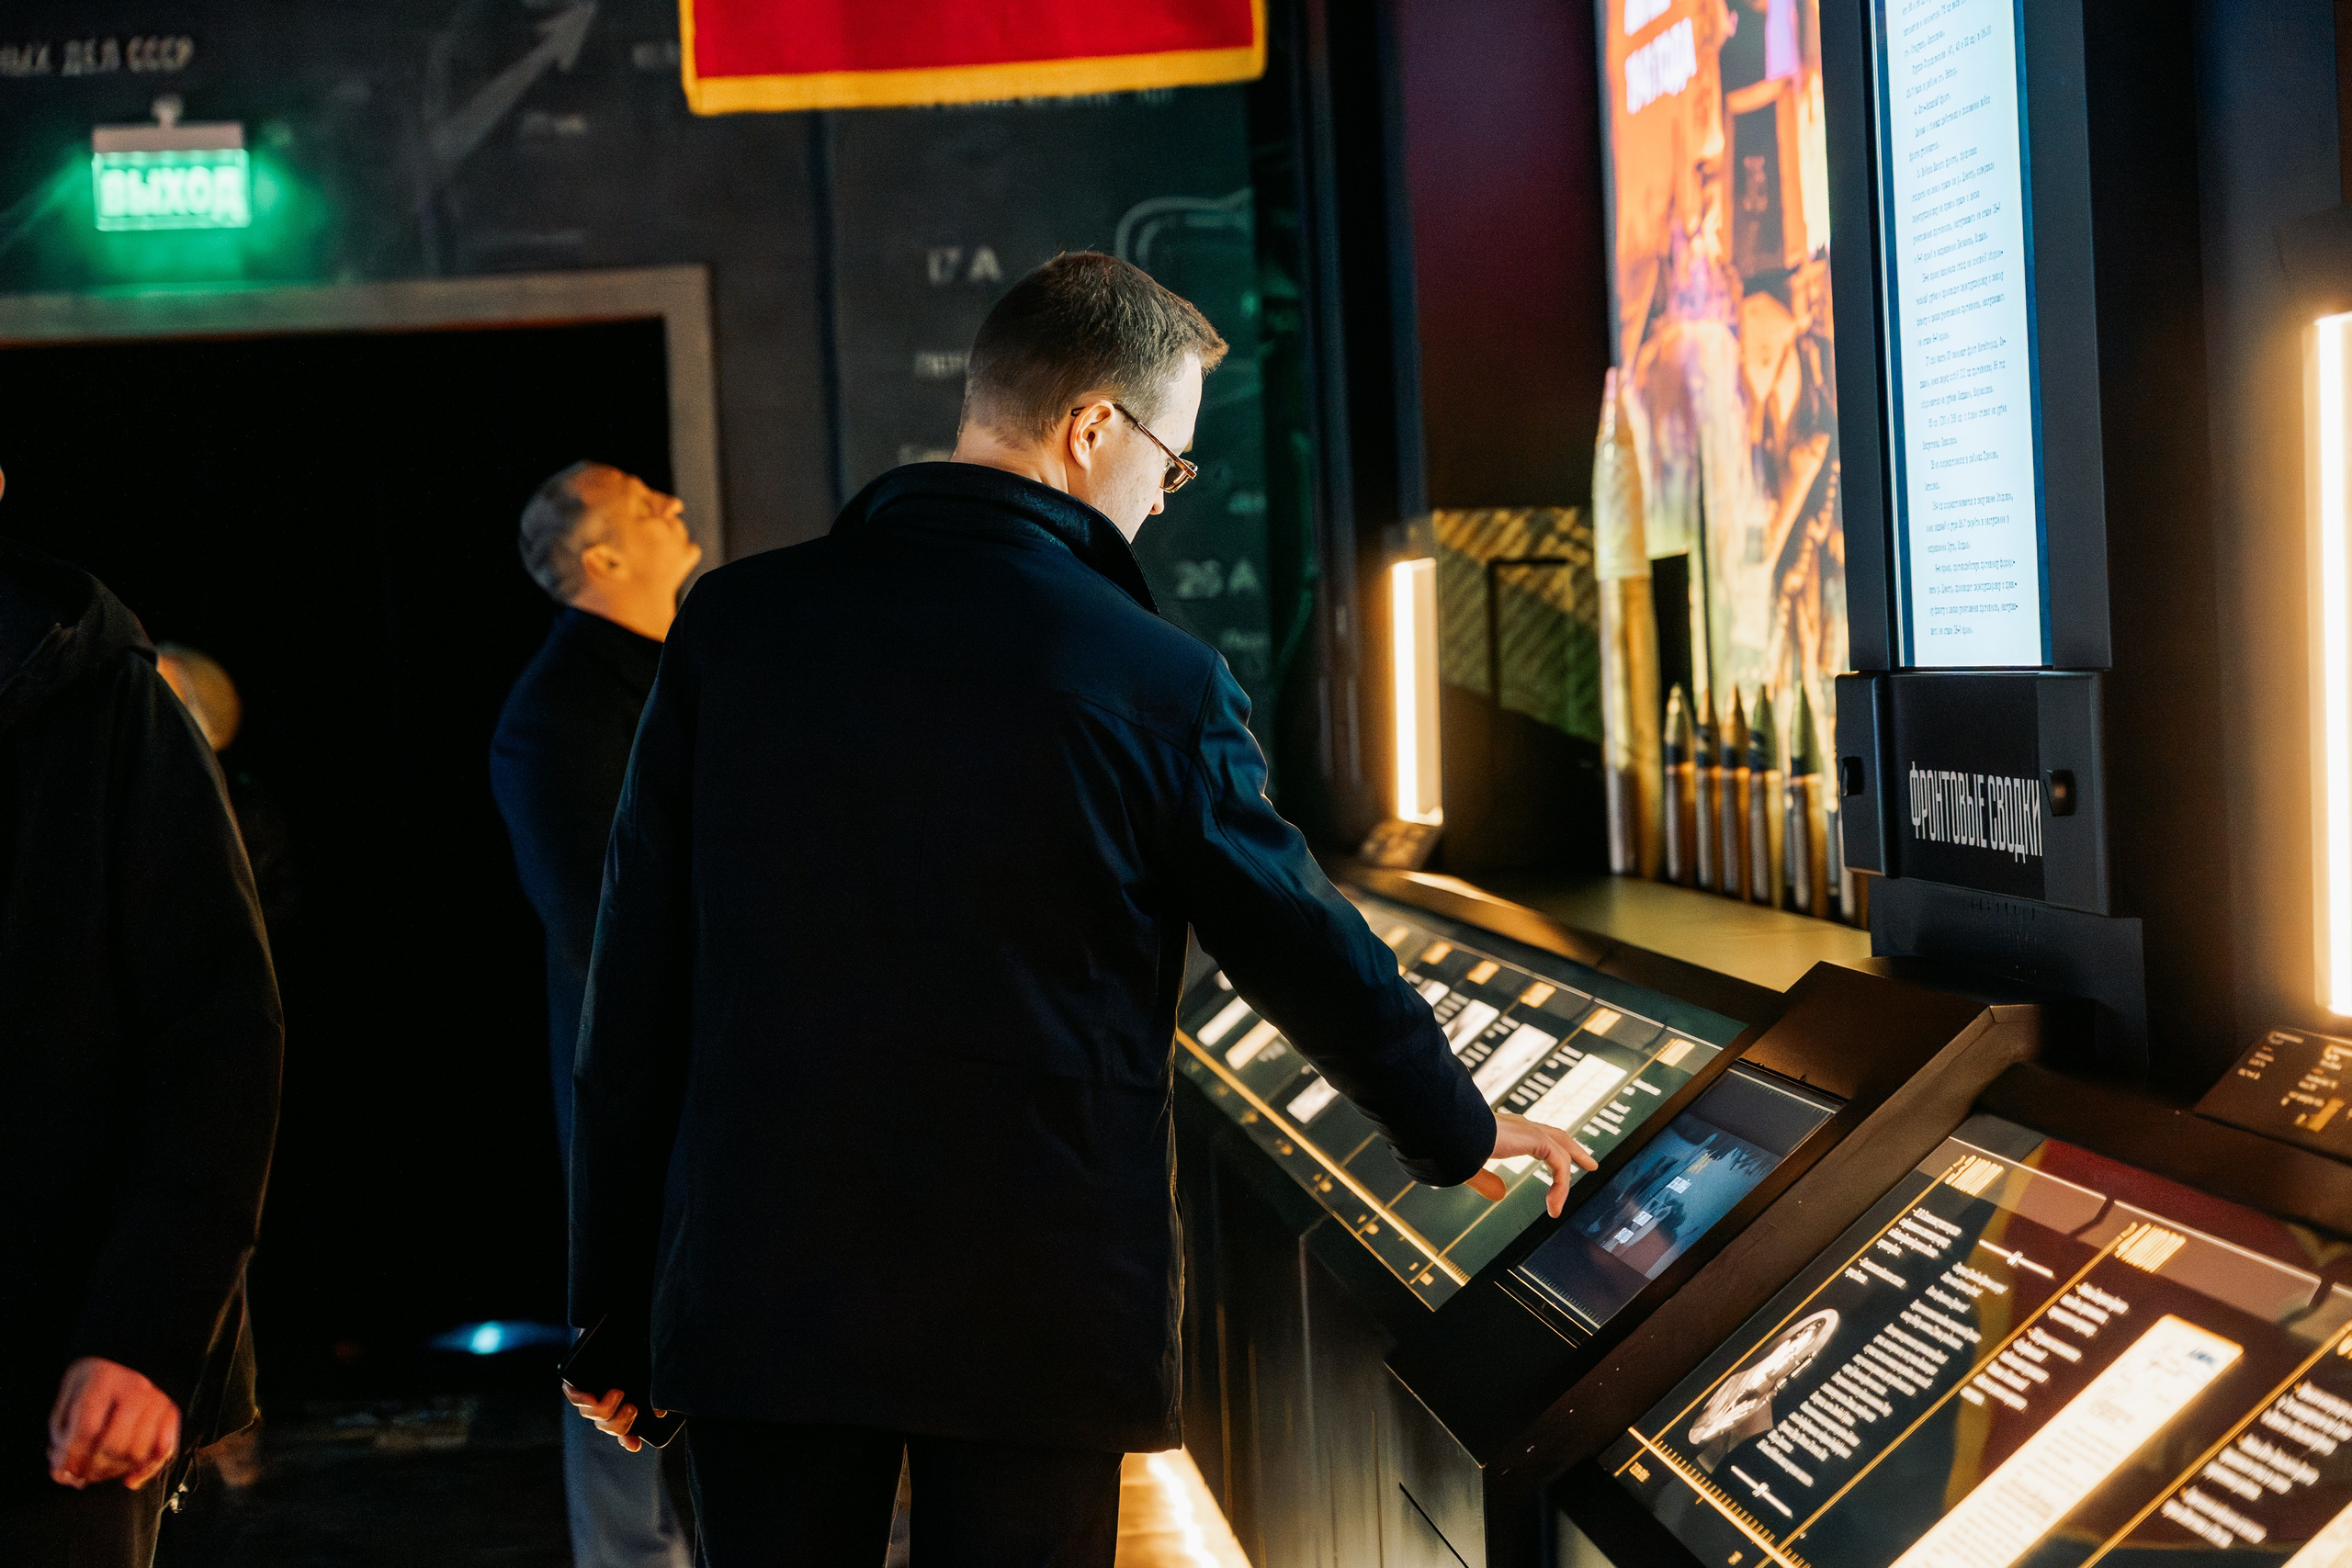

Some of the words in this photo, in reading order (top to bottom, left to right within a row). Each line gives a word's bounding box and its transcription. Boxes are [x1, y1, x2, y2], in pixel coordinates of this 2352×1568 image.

[126, 36, 194, 73] СССР
[100, 165, 249, 227] ВЫХОД
[1909, 761, 1987, 848] ФРОНТОВЫЕ
[1987, 775, 2042, 863] СВОДКИ
